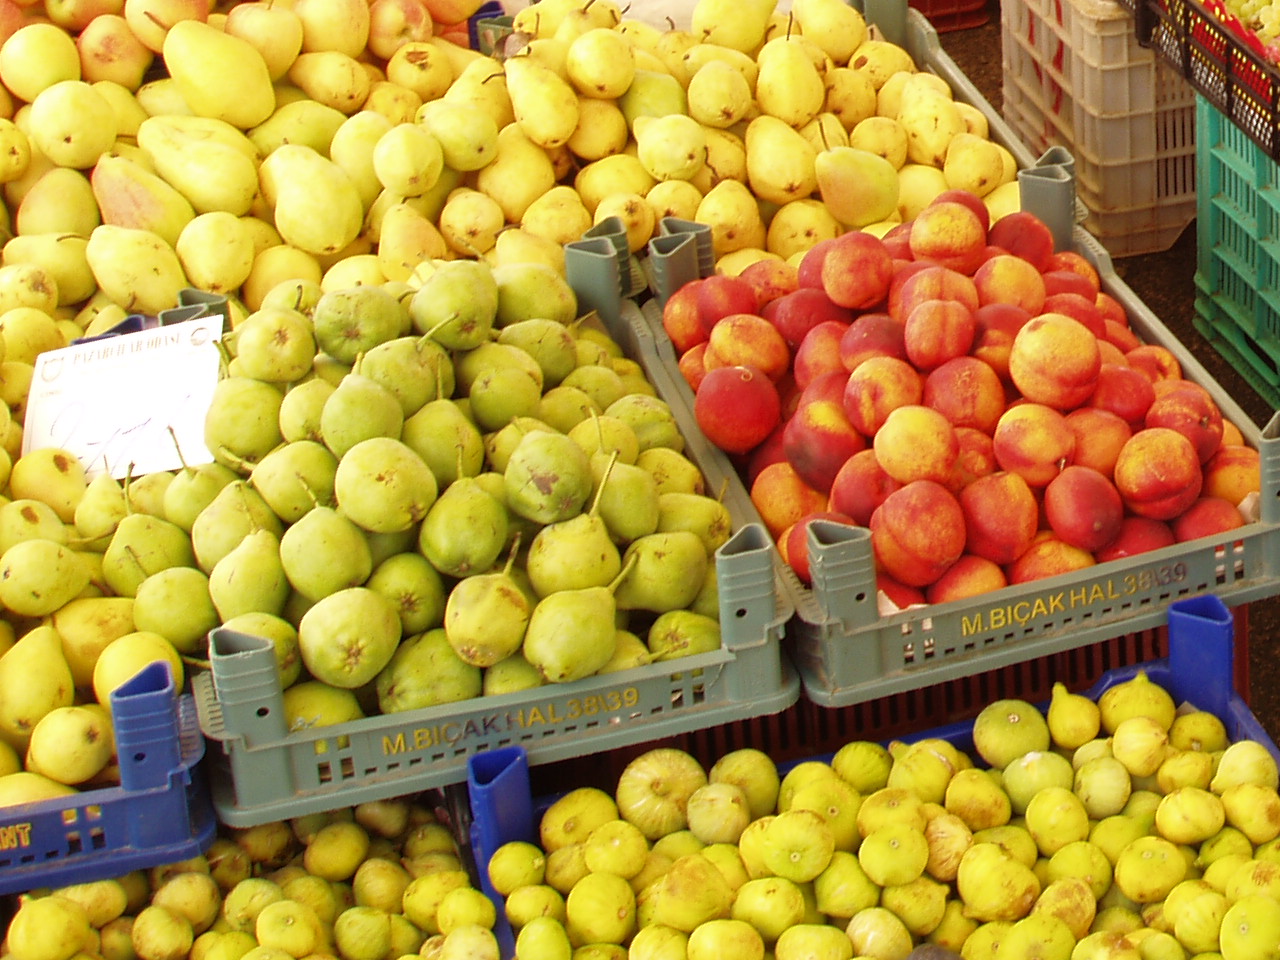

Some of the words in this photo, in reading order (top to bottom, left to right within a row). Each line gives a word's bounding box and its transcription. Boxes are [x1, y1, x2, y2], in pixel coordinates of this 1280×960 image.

[961, 592, 1066, 637] M.BIÇAK
[1069, 579, 1121, 609] HAL
[381, 711, 500, 755] M.BIÇAK
[505, 704, 563, 730] HAL
